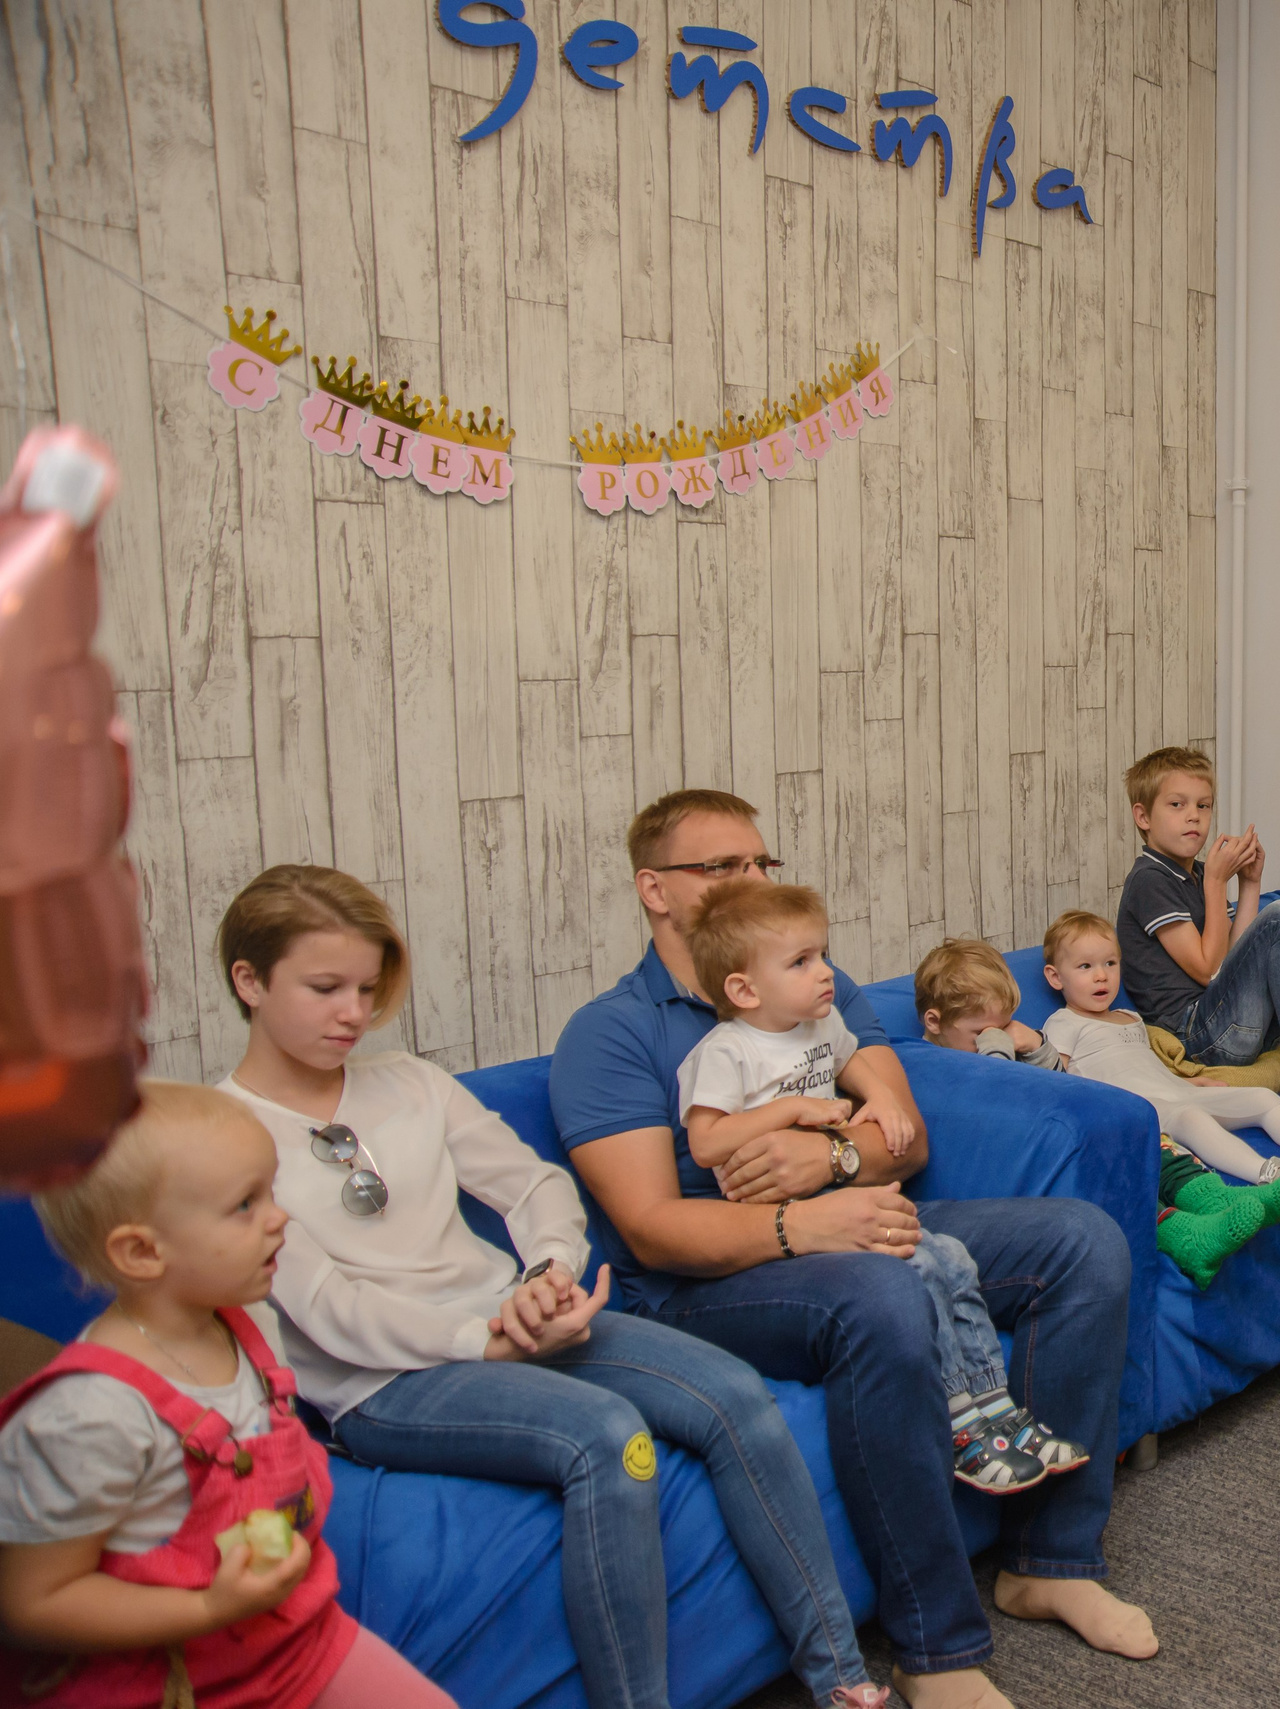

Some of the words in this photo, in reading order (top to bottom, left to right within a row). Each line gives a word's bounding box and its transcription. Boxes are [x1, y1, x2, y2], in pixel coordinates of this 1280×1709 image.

[227, 357, 264, 396] С
[312, 397, 504, 489] ДНЕМ
[596, 375, 889, 501] РОЖДЕНИЯ
